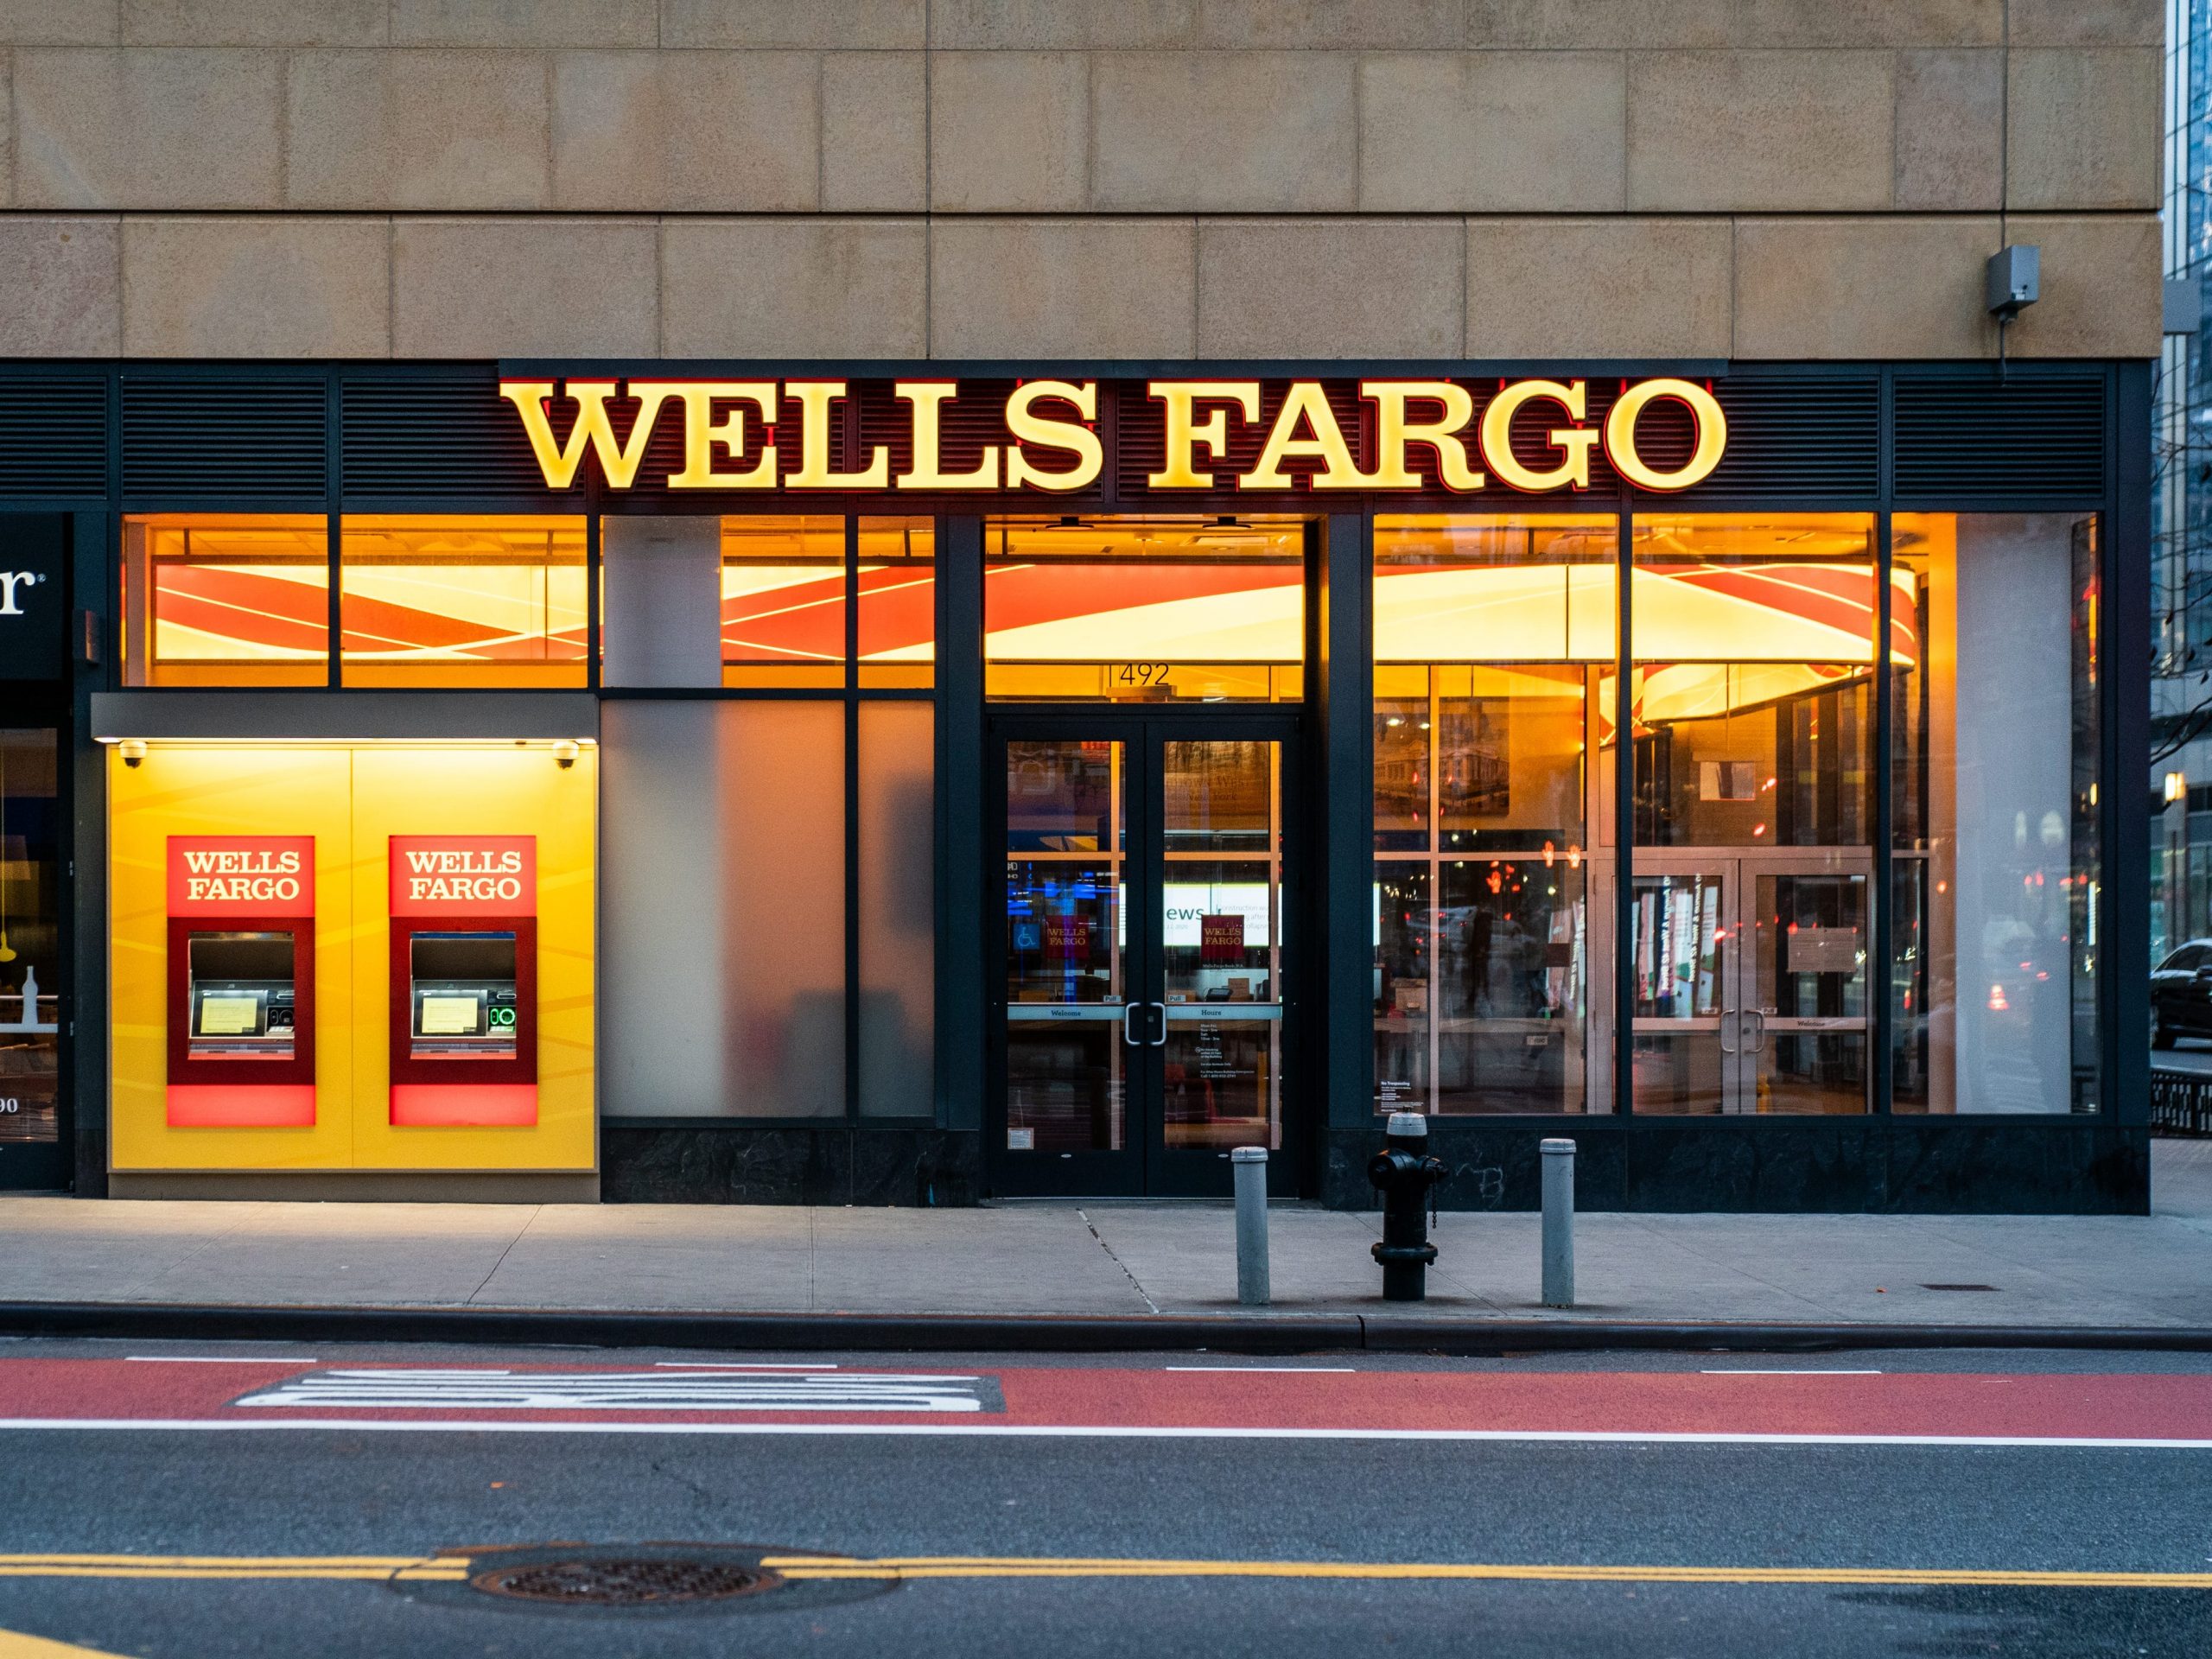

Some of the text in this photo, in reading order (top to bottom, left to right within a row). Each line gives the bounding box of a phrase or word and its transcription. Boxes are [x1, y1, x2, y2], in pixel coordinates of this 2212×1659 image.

[499, 378, 1726, 490] WELLS FARGO
[1120, 662, 1170, 686] 492
[183, 850, 300, 874] WELLS
[405, 850, 523, 874] WELLS
[187, 877, 300, 900] FARGO
[409, 877, 522, 900] FARGO
[1166, 909, 1205, 920] ews
[1048, 928, 1086, 937] WELLS
